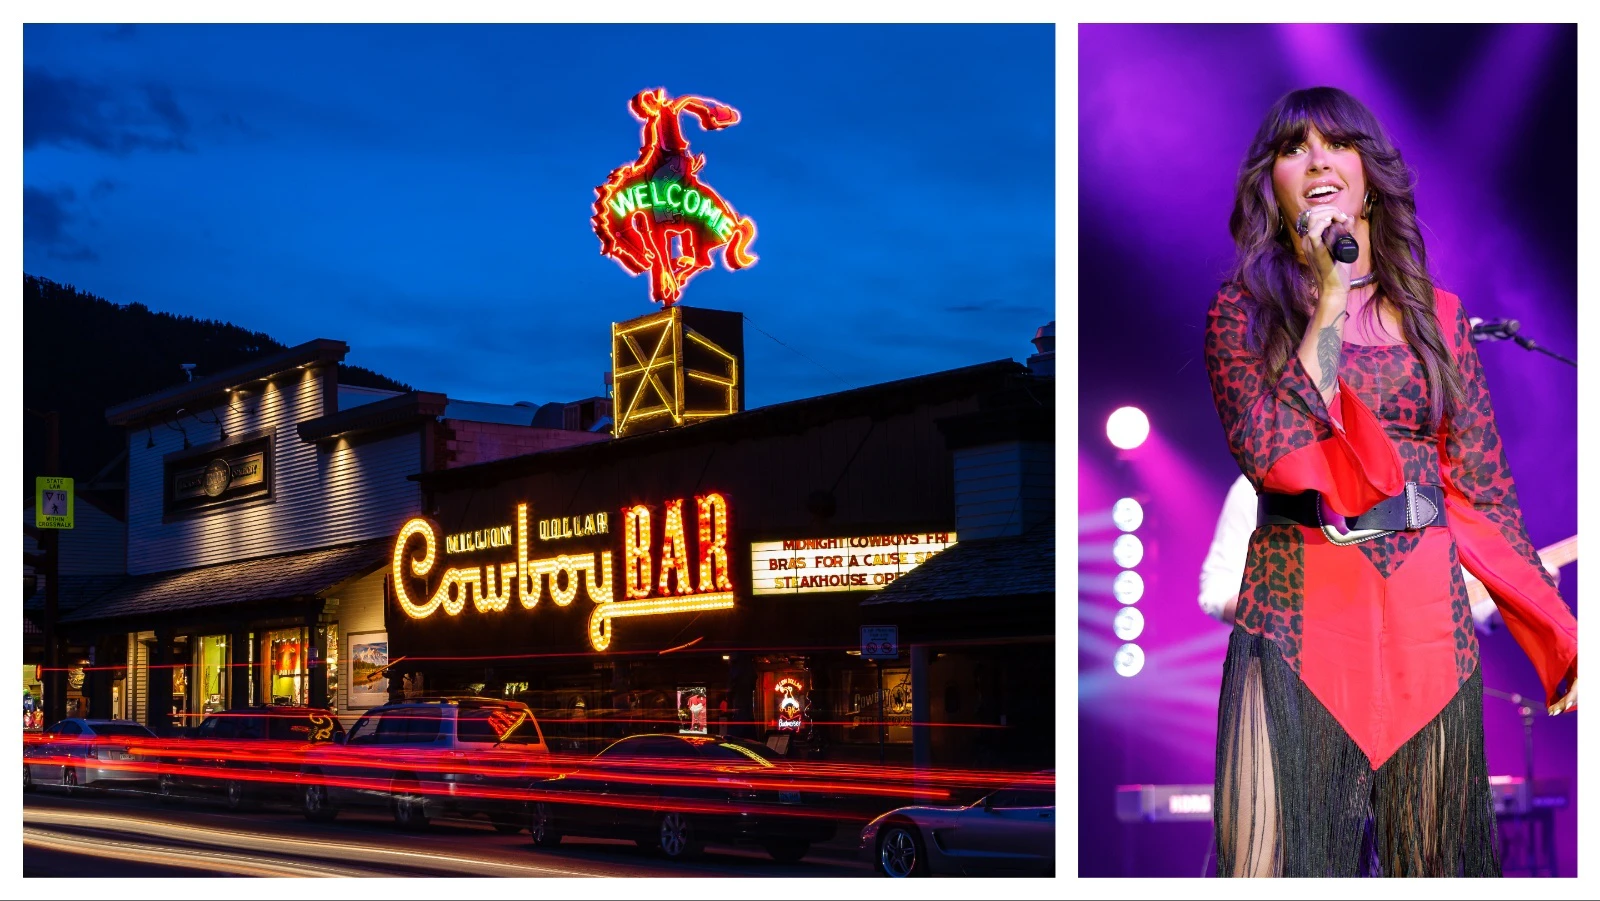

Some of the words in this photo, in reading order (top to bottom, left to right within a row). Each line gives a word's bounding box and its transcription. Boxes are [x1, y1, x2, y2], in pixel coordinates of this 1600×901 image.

[609, 182, 735, 242] WELCOME
[56, 493, 65, 501] TO
[446, 525, 512, 554] MILLION
[539, 512, 609, 541] DOLLAR
[783, 537, 844, 551] MIDNIGHT
[850, 533, 919, 548] COWBOYS
[926, 532, 949, 544] FRI
[769, 556, 807, 571] BRAS
[815, 555, 843, 568] FOR
[848, 554, 859, 567] A
[863, 552, 909, 566] CAUSE
[392, 503, 613, 652] Cowboy
[620, 493, 734, 600] BAR
[774, 573, 868, 589] STEAKHOUSE
[778, 718, 802, 728] Budweiser
